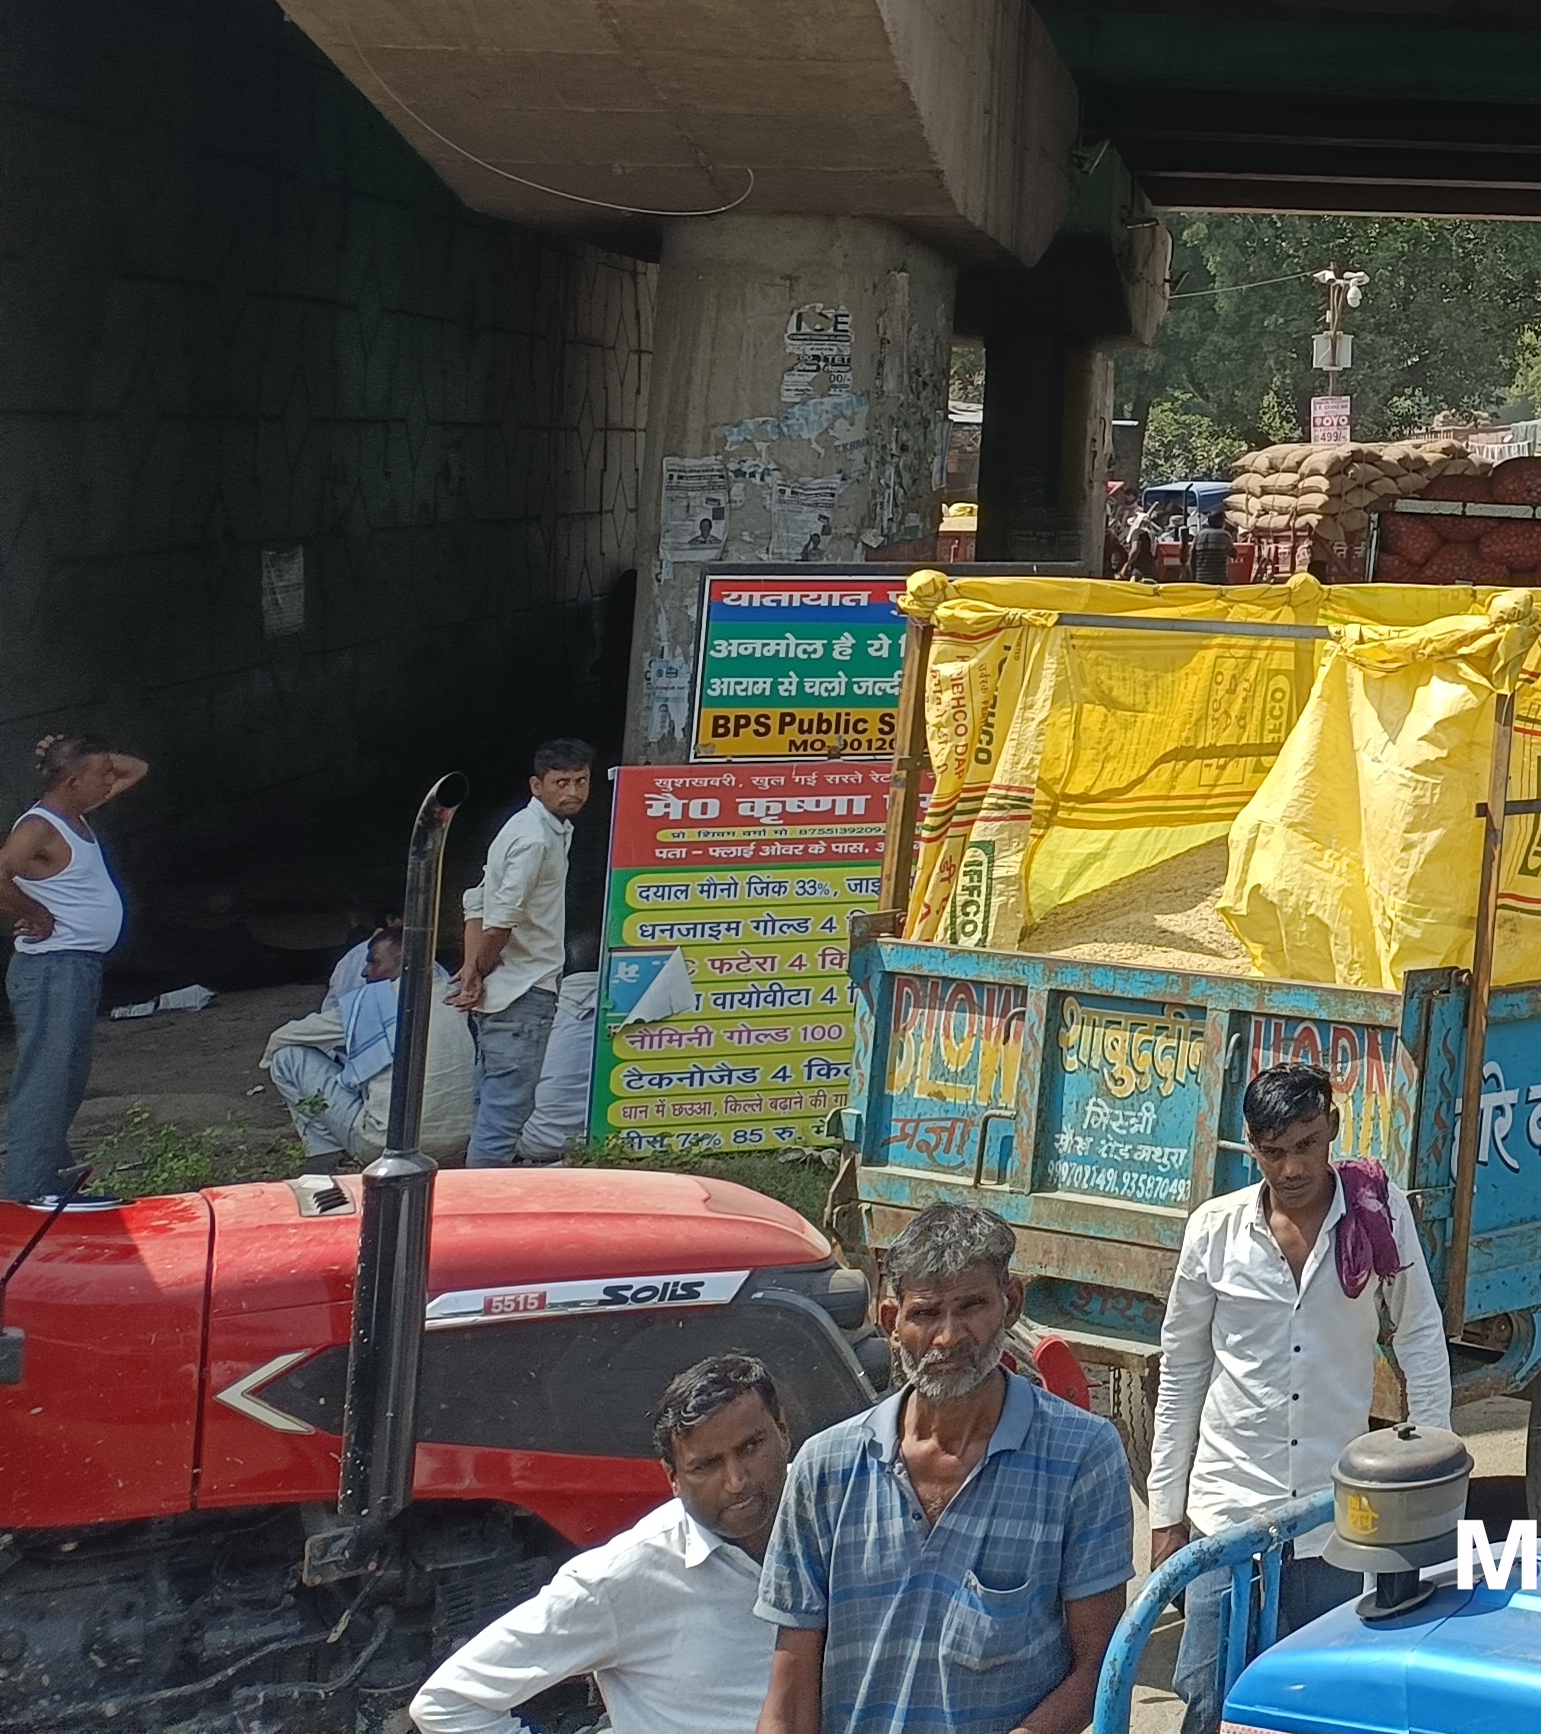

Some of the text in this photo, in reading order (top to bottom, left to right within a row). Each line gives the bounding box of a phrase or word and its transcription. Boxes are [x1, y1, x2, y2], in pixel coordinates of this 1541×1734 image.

[1322, 416, 1349, 426] OYO
[721, 590, 872, 608] यातायात
[709, 632, 828, 659] अनमोल
[832, 632, 856, 660] है
[867, 633, 892, 658] ये
[707, 677, 773, 697] आराम
[777, 671, 800, 697] से
[803, 671, 848, 697] चलो
[711, 713, 772, 739] BPS
[777, 712, 869, 737] Public
[735, 794, 872, 825] कृष्णा
[655, 847, 688, 859] पता
[708, 842, 755, 859] फ्लाई
[759, 842, 804, 857] ओवर
[807, 842, 826, 855] के
[636, 883, 690, 902] दयाल
[746, 874, 789, 899] जिंक
[638, 913, 837, 941] धनजाइम गोल्ड 4
[707, 950, 778, 974] फटेरा
[788, 954, 808, 971] 4
[820, 987, 838, 1004] 4
[723, 1023, 791, 1046] गोल्ड
[801, 1024, 843, 1042] 100
[770, 1065, 792, 1082] 4
[622, 1105, 648, 1120] धान
[732, 1127, 763, 1144] 85
[490, 1293, 540, 1313] 5515
